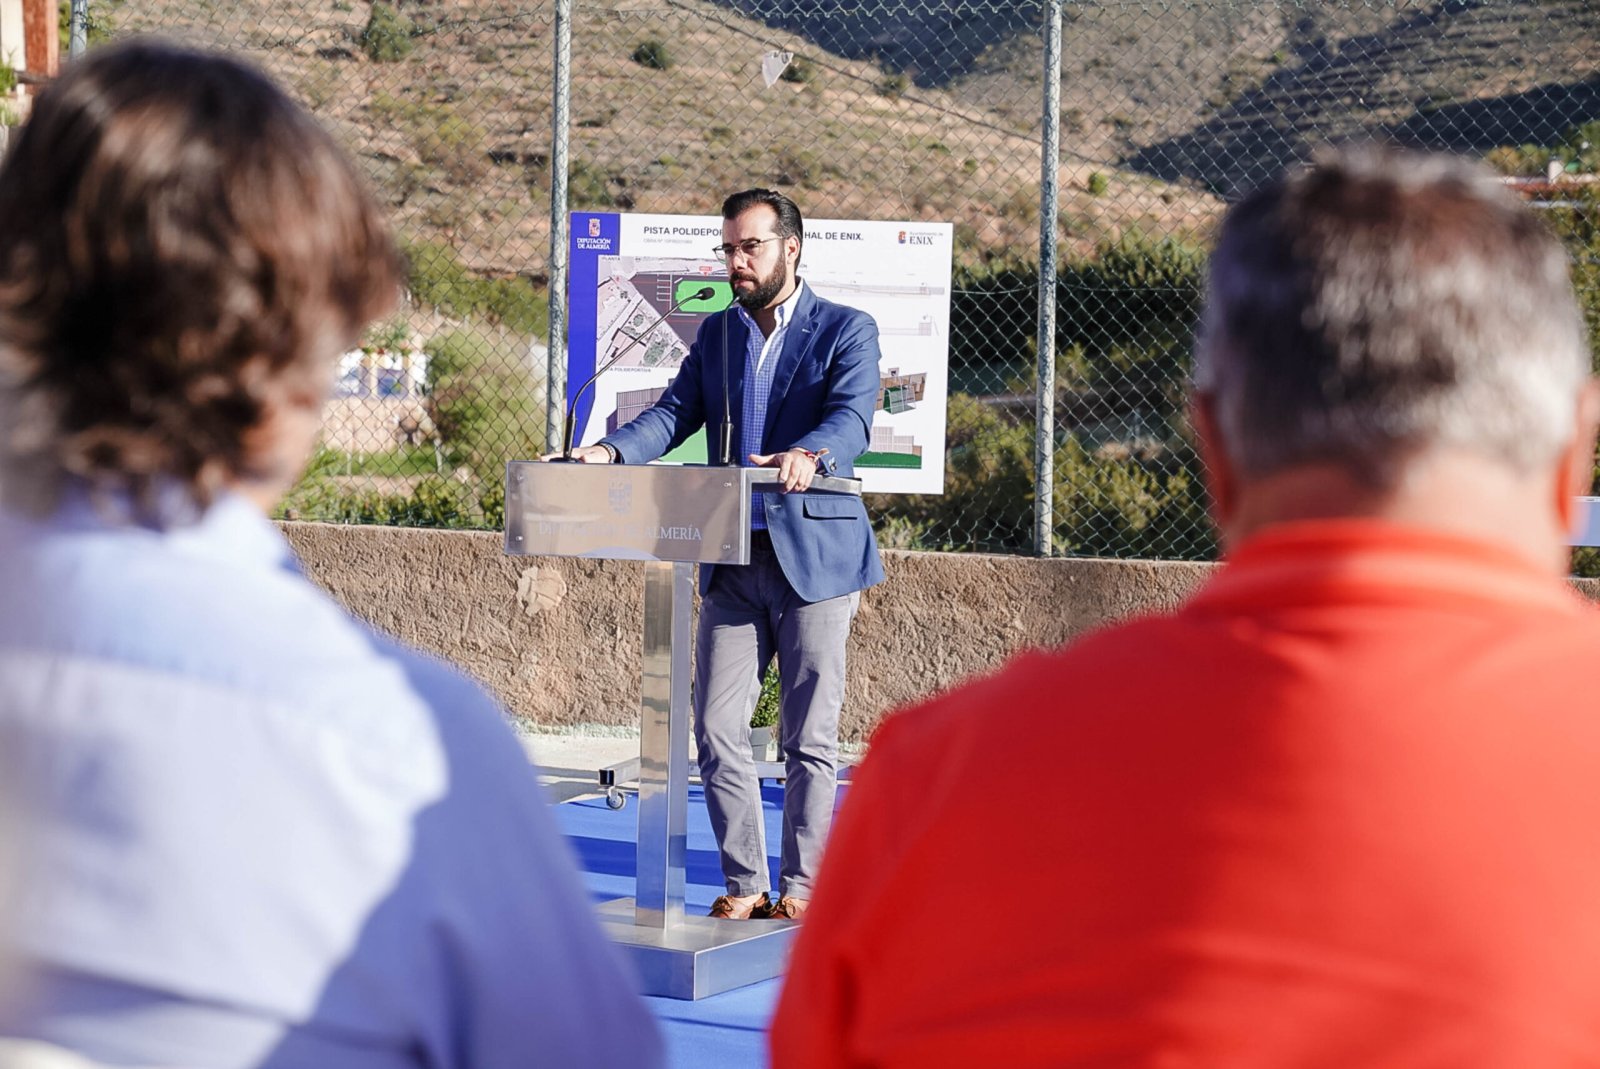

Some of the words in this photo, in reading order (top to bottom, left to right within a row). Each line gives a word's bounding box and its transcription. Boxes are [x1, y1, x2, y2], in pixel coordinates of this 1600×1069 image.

[643, 226, 670, 235] PISTA
[804, 231, 823, 240] HAL
[825, 232, 838, 240] DE
[840, 232, 864, 241] ENIX.
[576, 237, 611, 245] DIPUTACIÓN
[909, 236, 933, 245] ENIX
[586, 243, 610, 251] ALMERÍA
[643, 524, 702, 540] ALMERÍA
